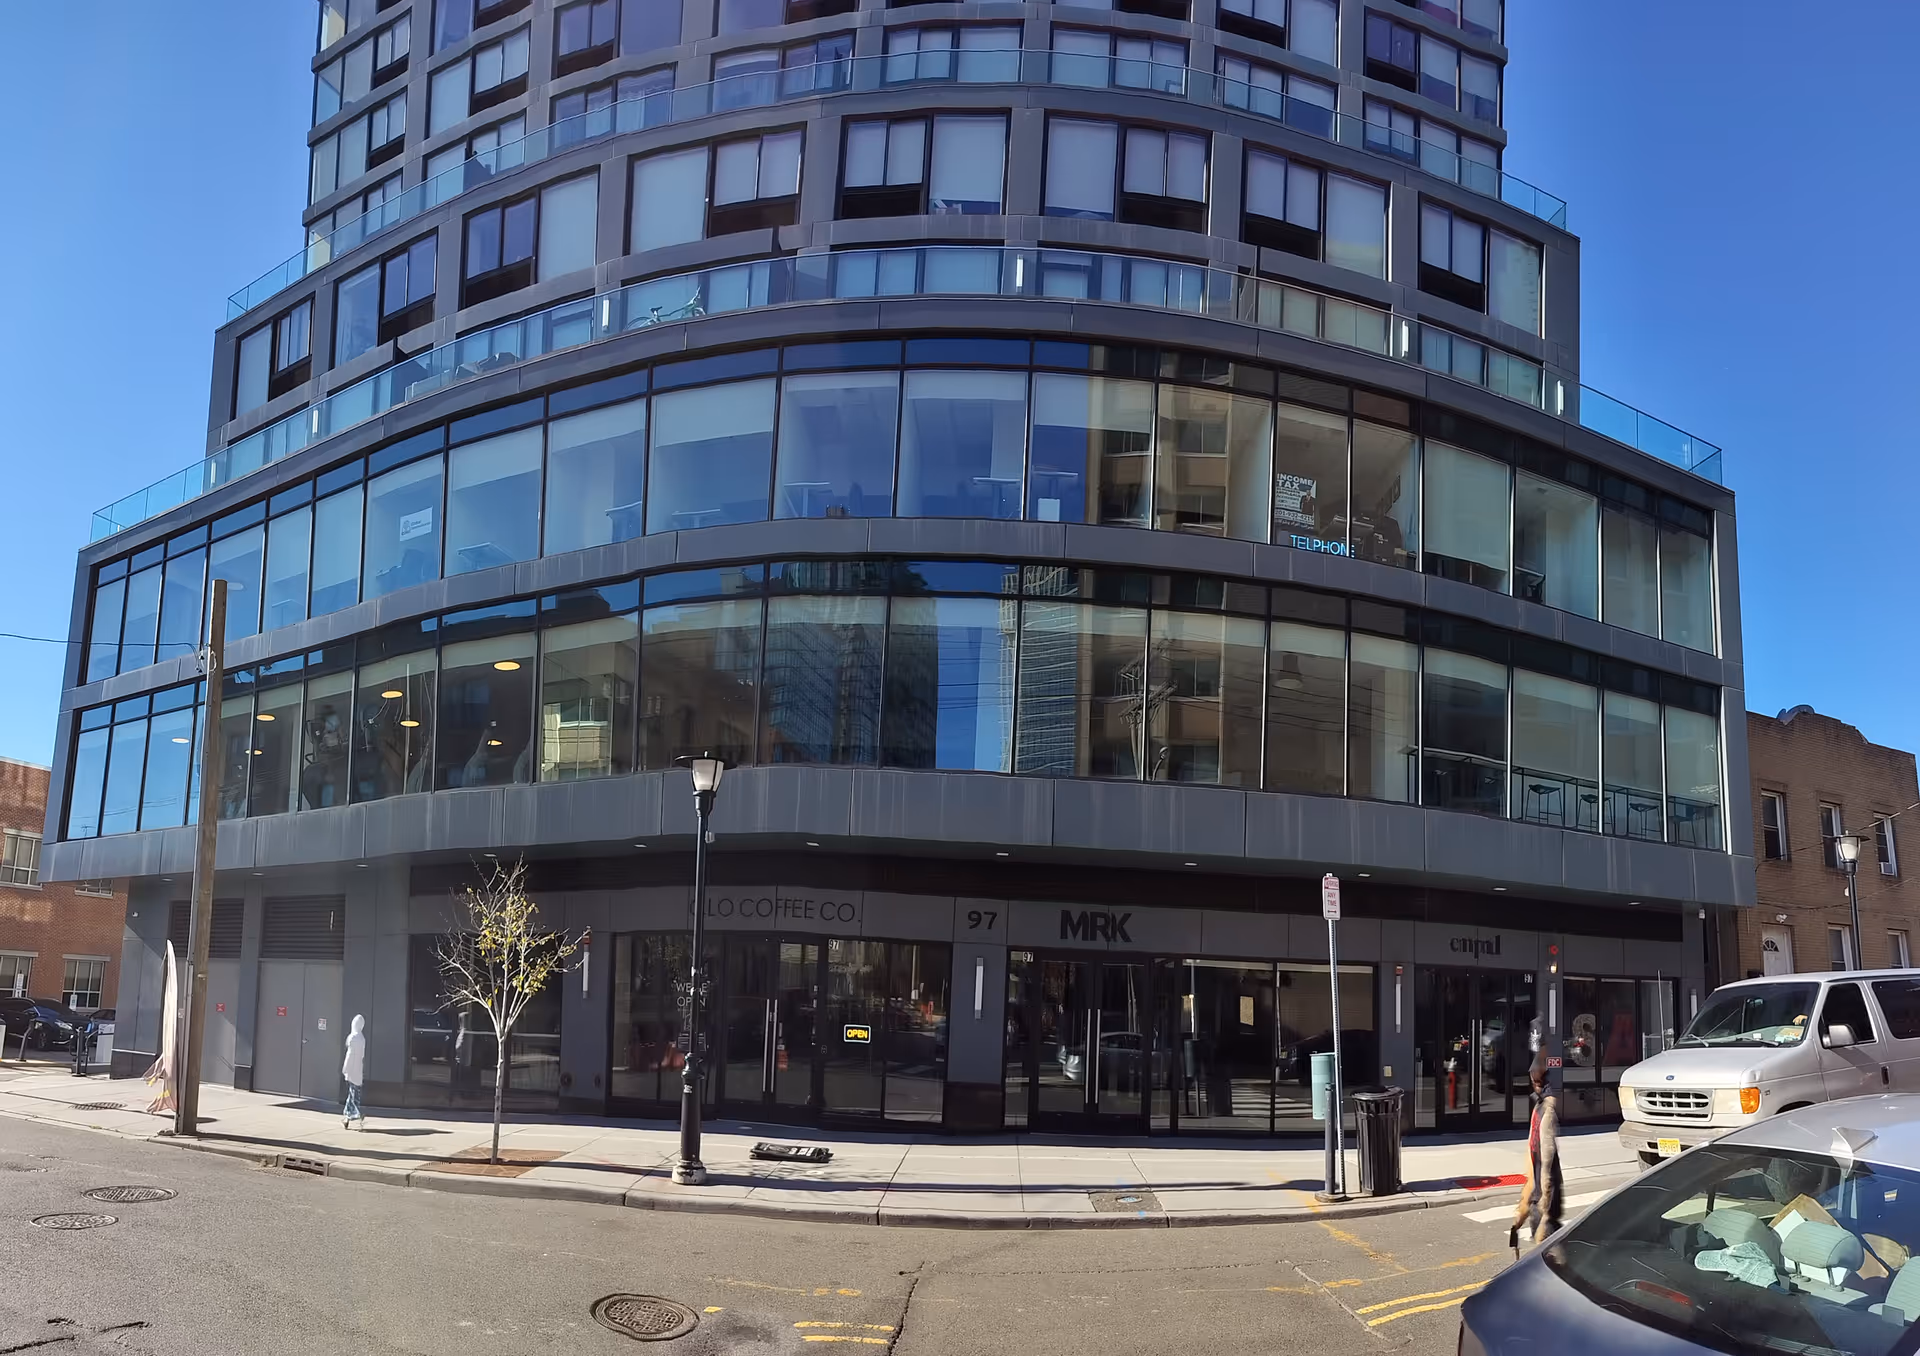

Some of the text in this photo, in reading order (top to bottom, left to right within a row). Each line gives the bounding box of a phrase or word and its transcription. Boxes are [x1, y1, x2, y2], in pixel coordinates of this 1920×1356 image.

[1277, 473, 1313, 486] INCOME
[1277, 479, 1300, 490] TAX
[739, 898, 814, 919] COFFEE
[967, 910, 998, 930] 97
[1060, 909, 1133, 943] MRK
[828, 939, 839, 950] 97
[1022, 951, 1033, 962] 97
[677, 996, 706, 1007] OPN
[846, 1029, 868, 1038] OPEN
[1547, 1058, 1560, 1067] FDC
